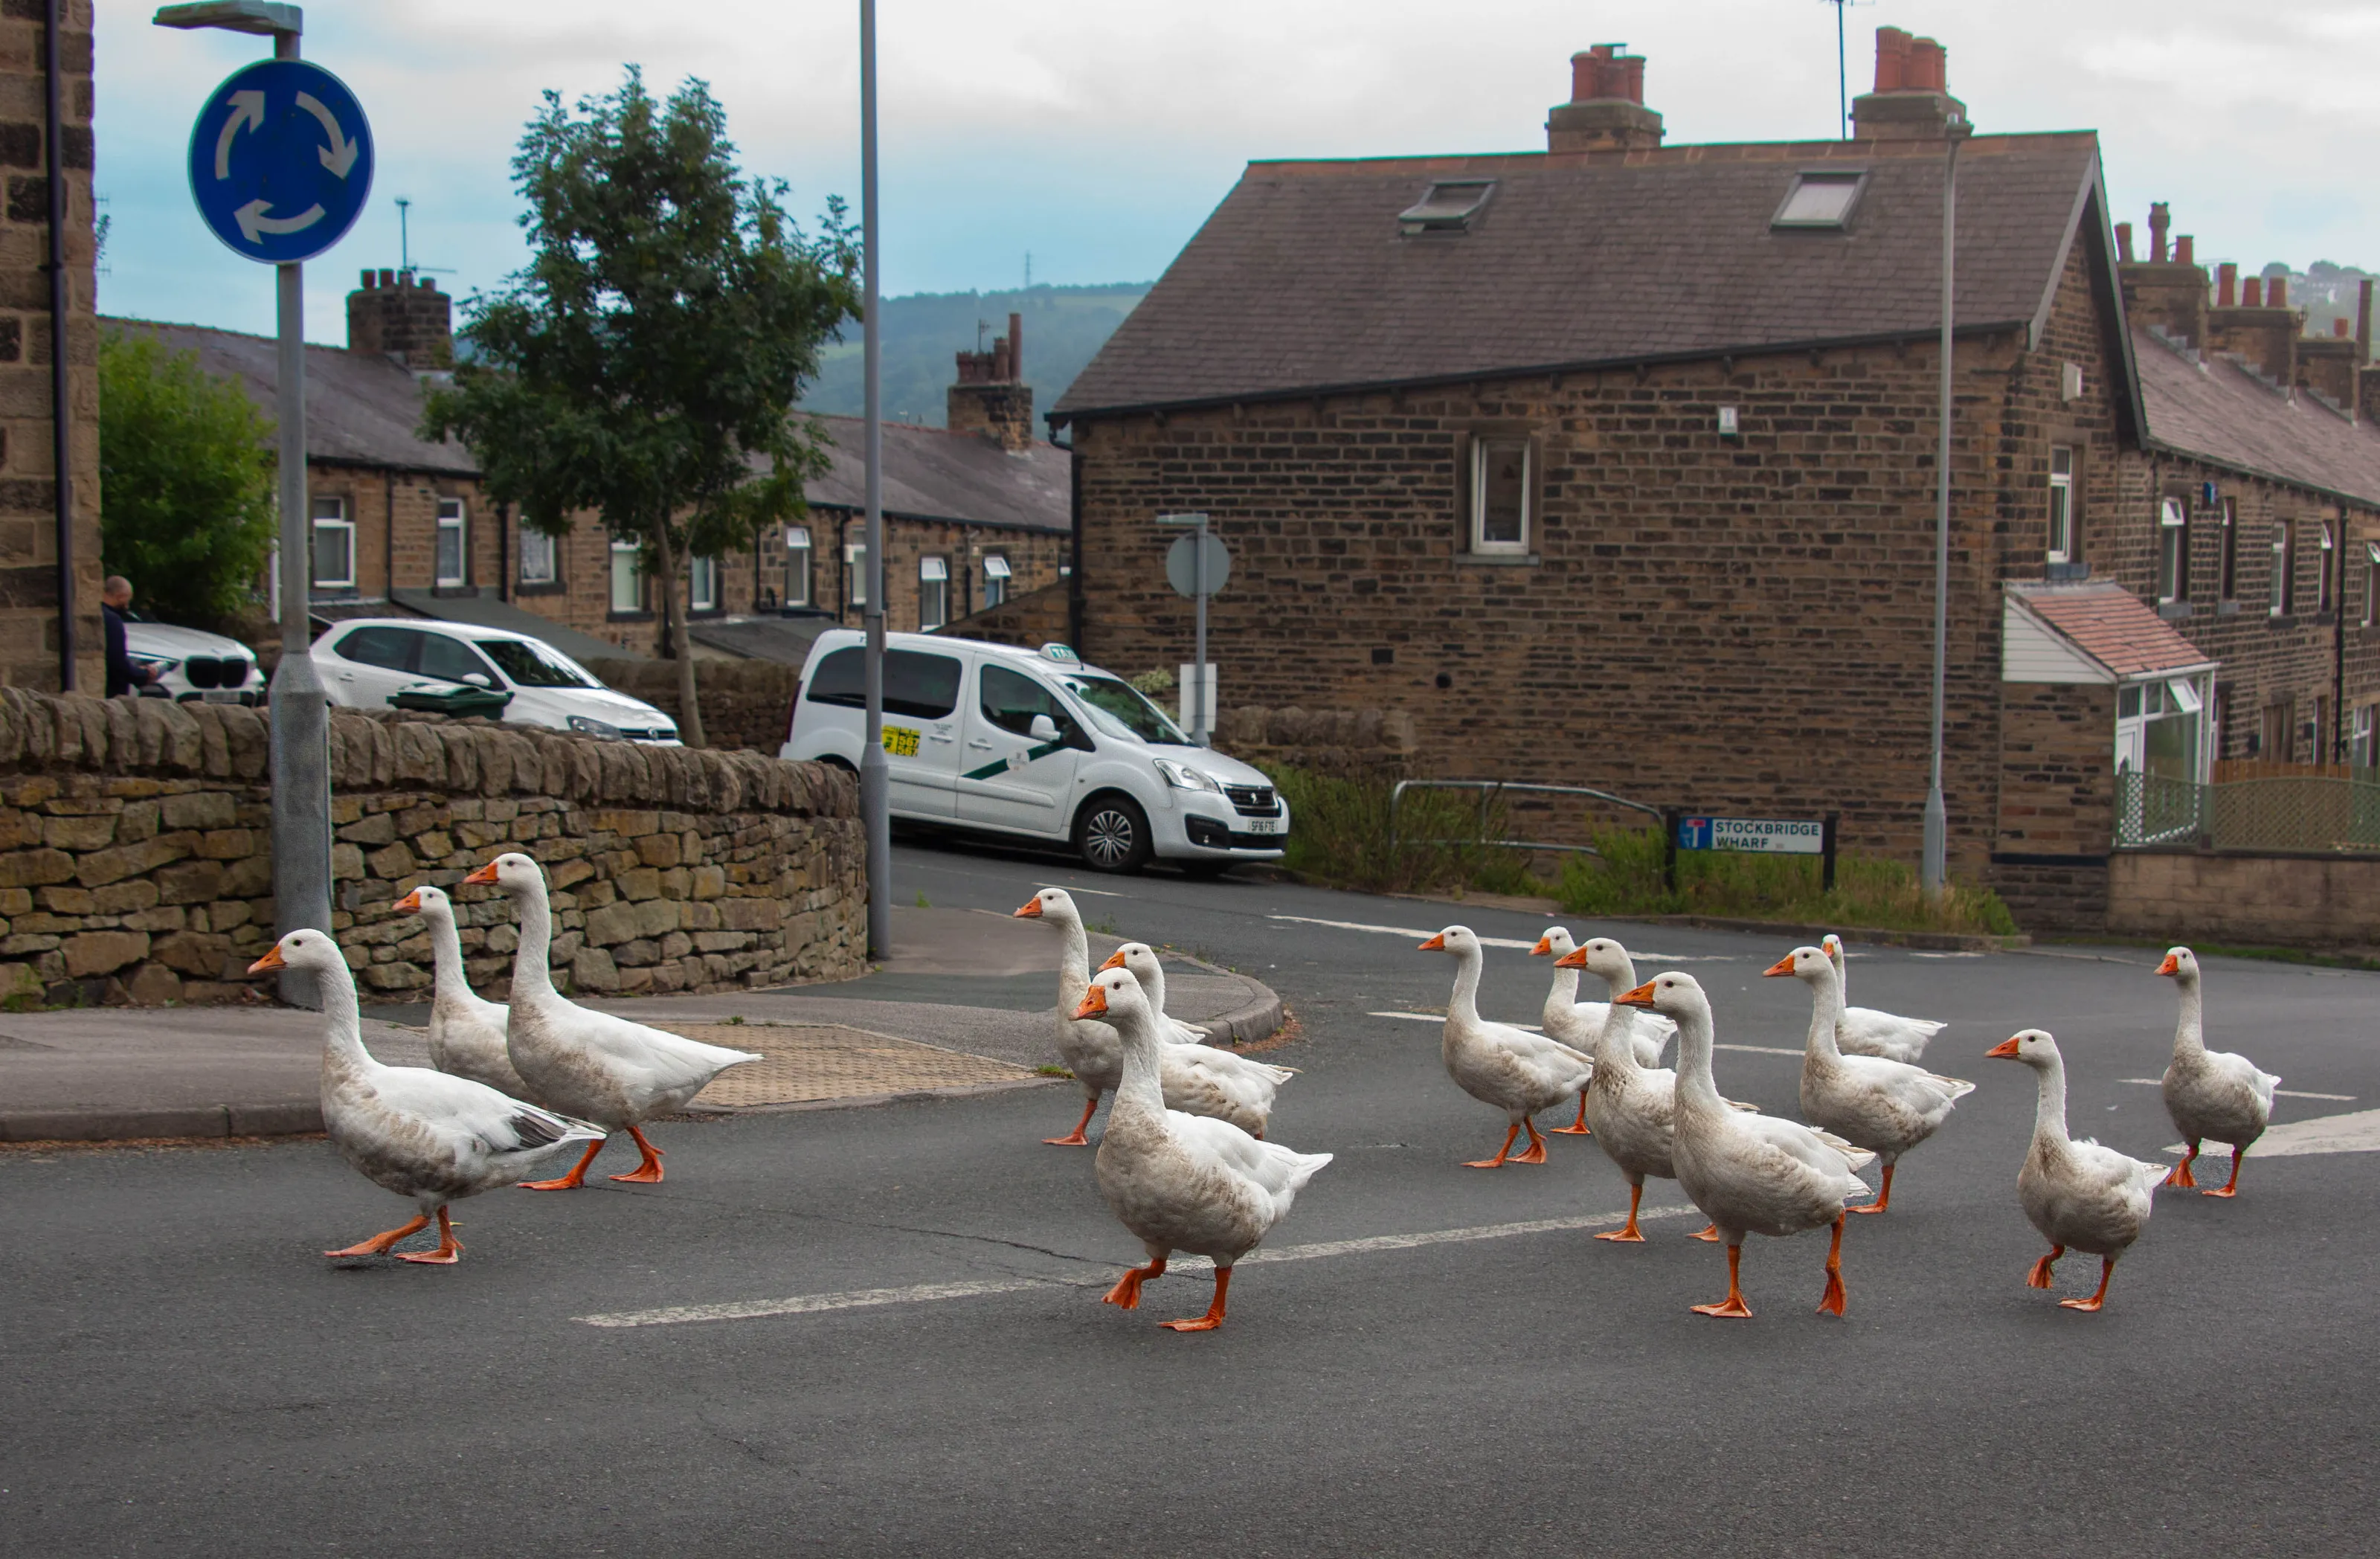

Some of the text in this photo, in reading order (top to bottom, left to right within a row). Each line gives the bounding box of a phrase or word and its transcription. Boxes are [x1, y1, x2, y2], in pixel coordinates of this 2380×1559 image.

[1051, 648, 1077, 658] TAXI
[1716, 822, 1819, 835] STOCKBRIDGE
[1717, 836, 1769, 849] WHARF
